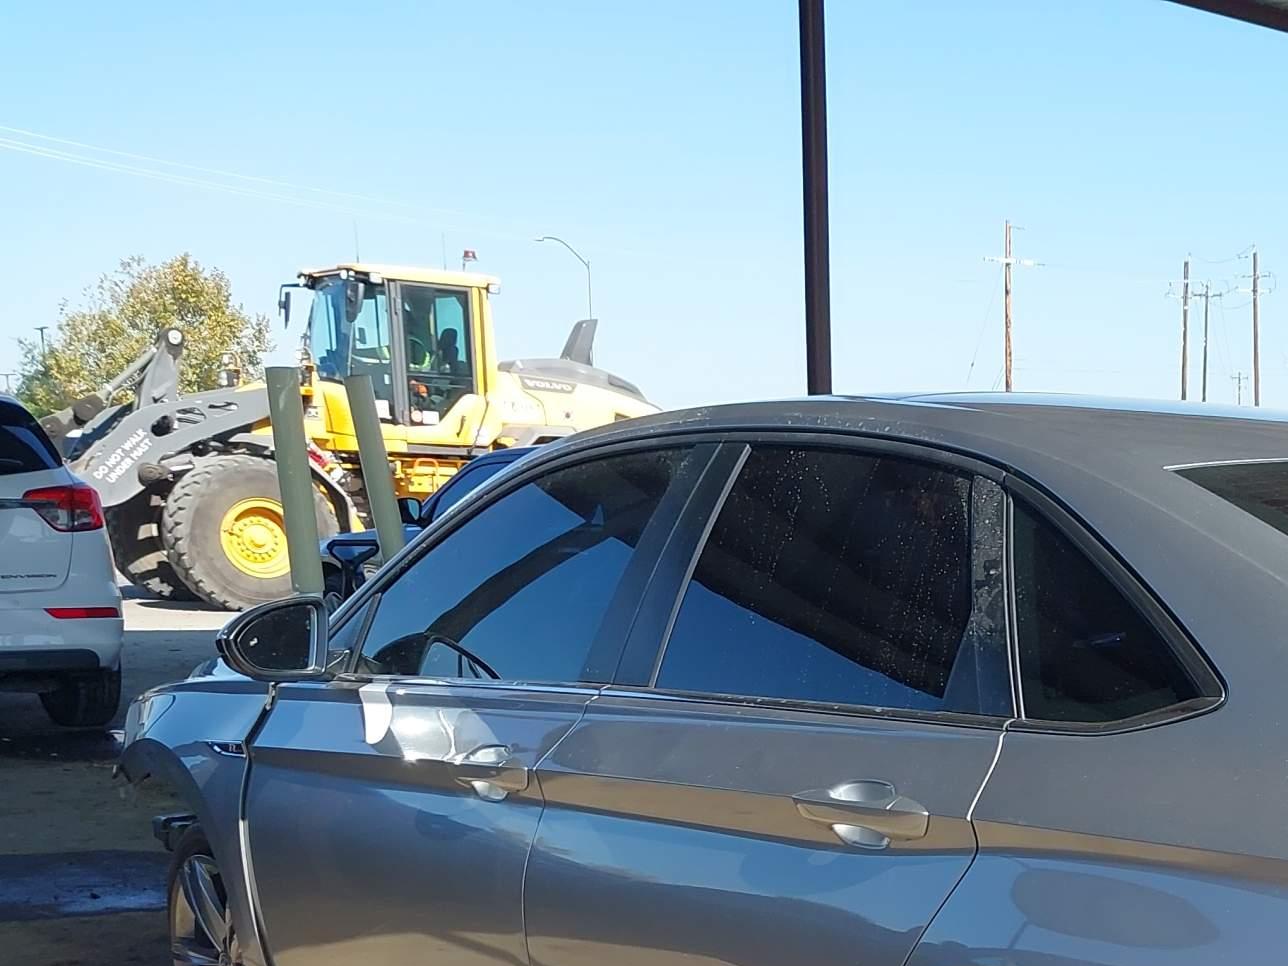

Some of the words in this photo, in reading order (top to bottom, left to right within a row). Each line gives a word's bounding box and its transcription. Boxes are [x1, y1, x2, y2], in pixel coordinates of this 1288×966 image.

[523, 379, 572, 391] VOLVO
[93, 465, 108, 479] DO
[105, 448, 125, 468] NOT
[120, 428, 147, 451] WALK
[105, 457, 135, 483] UNDER
[130, 438, 153, 460] MAST
